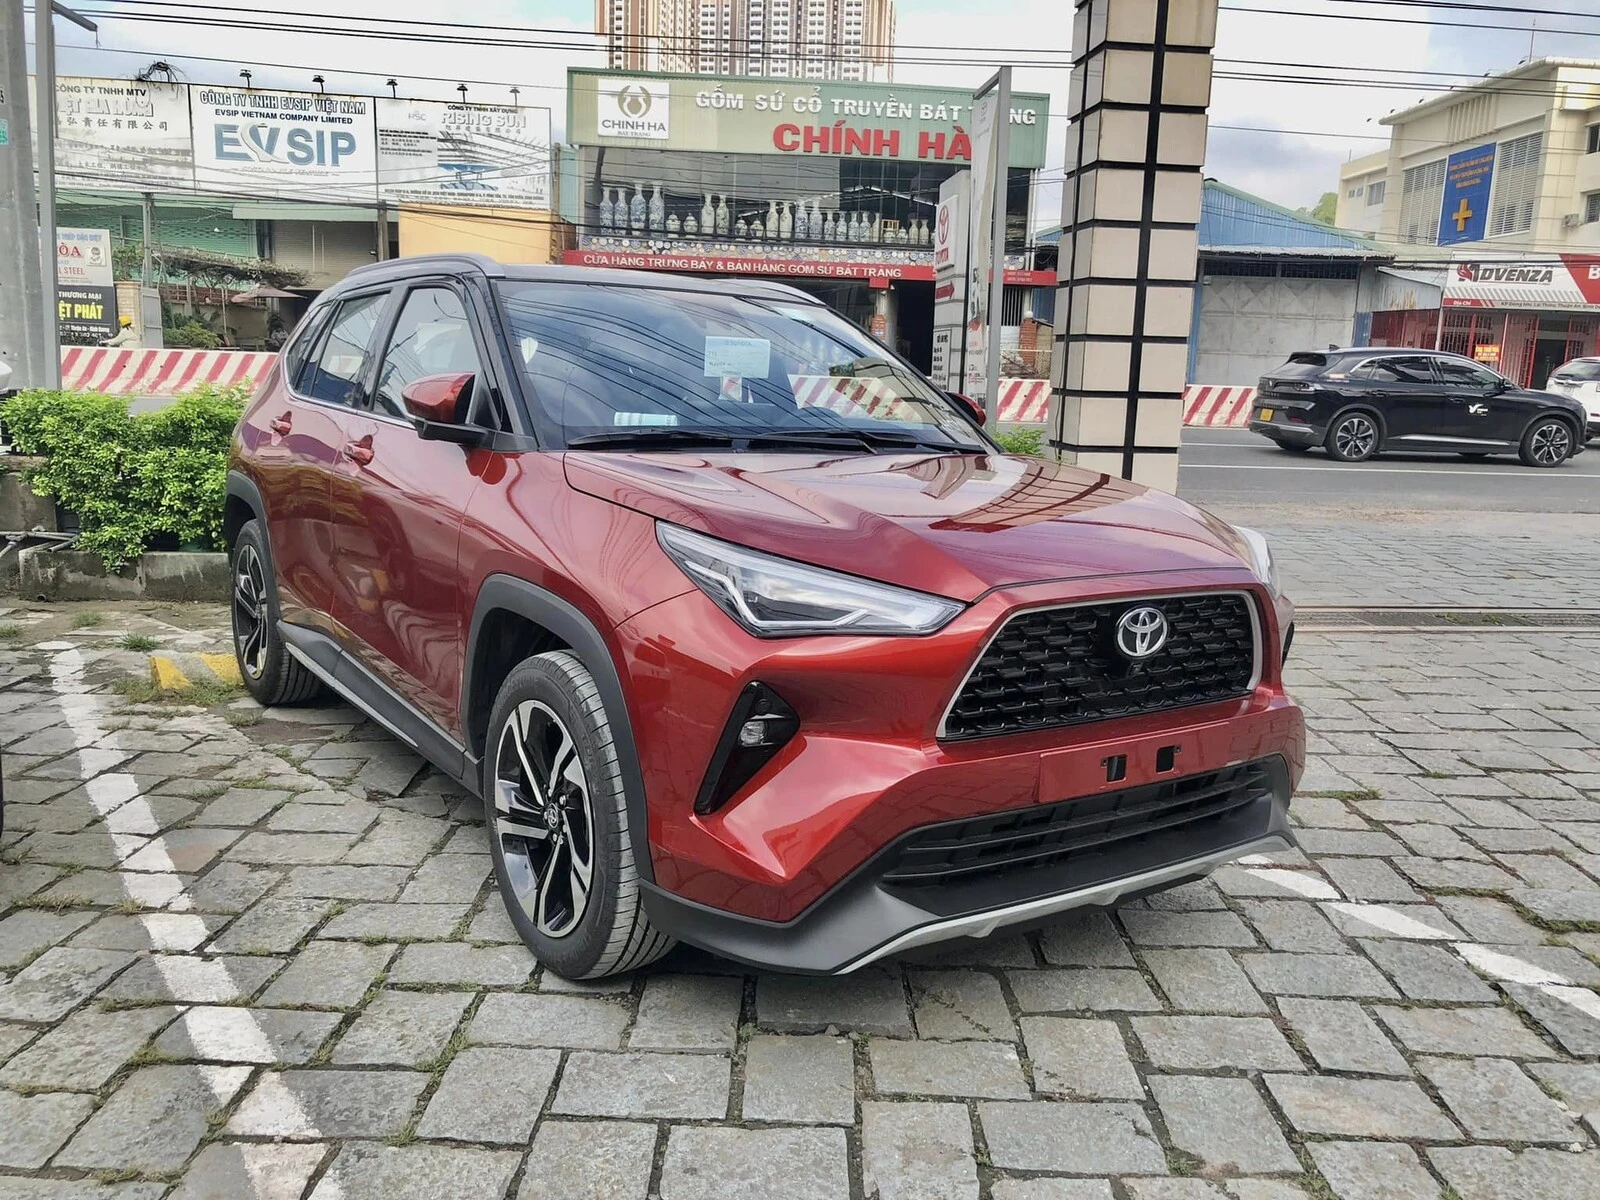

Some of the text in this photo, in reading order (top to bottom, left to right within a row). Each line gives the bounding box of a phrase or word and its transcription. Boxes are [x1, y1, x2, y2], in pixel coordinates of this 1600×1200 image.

[83, 86, 95, 94] TY
[97, 87, 124, 95] TNHH
[126, 88, 147, 97] MTV
[200, 89, 366, 116] CÔNG TY TNHH EVSIP VIỆT NAM
[696, 83, 744, 110] GỐM
[754, 89, 786, 112] SỨ
[793, 86, 822, 114] CỔ
[831, 94, 913, 119] TRUYỀN
[919, 100, 963, 121] BÁT
[215, 109, 353, 125] EVSIP VIETNAM COMPANY LIMITED
[441, 112, 526, 128] RISING SUN
[601, 119, 666, 132] CHINH HA
[214, 123, 357, 167] EVSIP
[773, 120, 972, 160] CHÍNH HÀ
[59, 242, 81, 257] ÒA
[64, 267, 84, 275] STEEL
[611, 254, 645, 267] HÀNG
[648, 257, 688, 269] TRƯNG
[716, 261, 724, 271] &
[727, 260, 751, 271] BÁN
[753, 260, 786, 273] HÀNG
[836, 264, 860, 276] BÁT
[88, 293, 101, 301] MẠI
[59, 300, 103, 321] ỆT PHÁT
